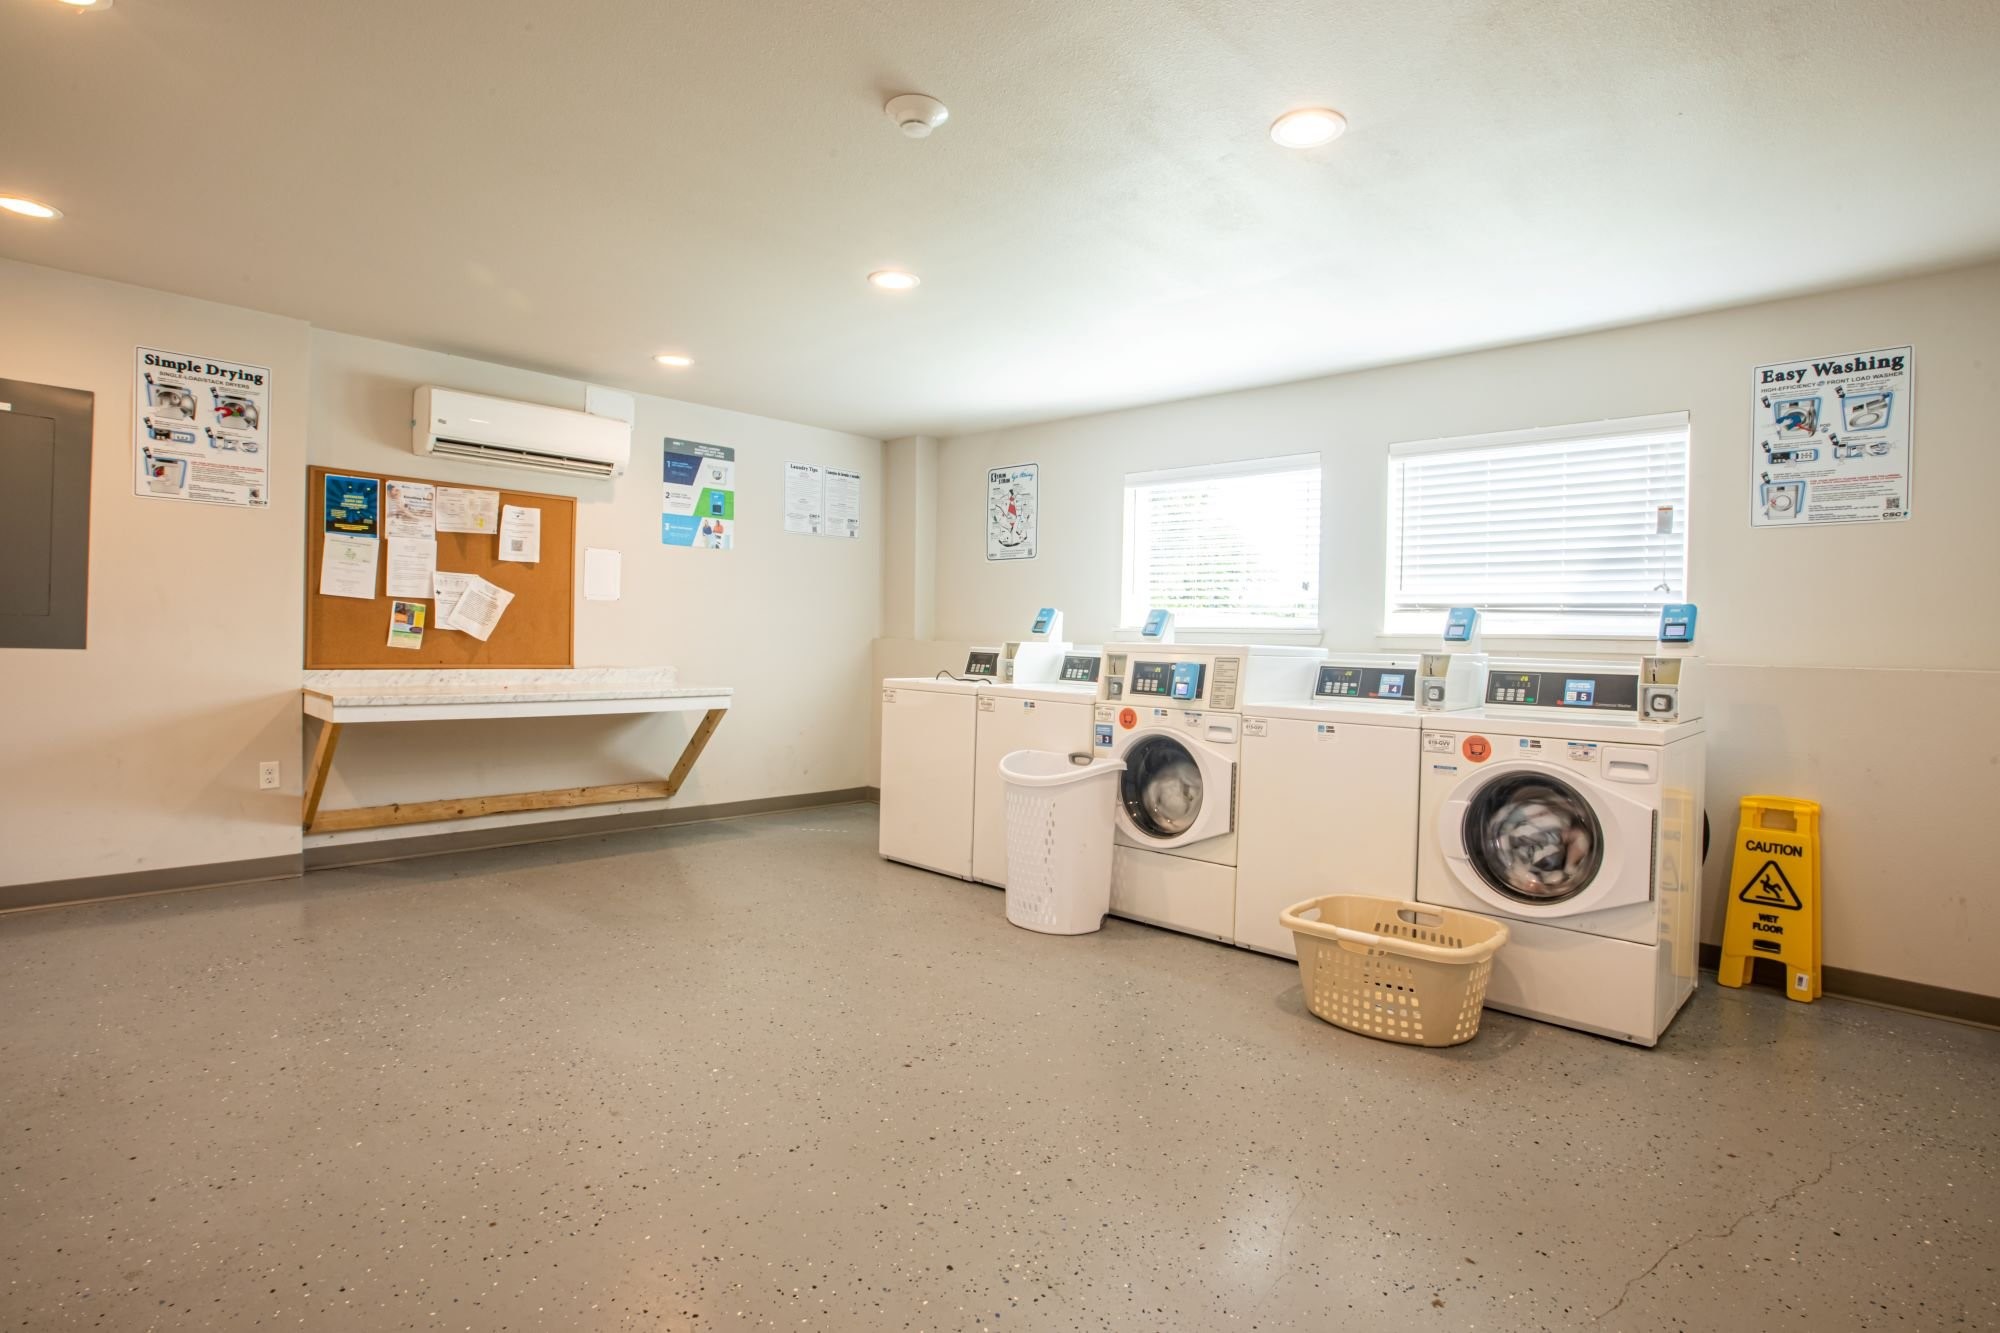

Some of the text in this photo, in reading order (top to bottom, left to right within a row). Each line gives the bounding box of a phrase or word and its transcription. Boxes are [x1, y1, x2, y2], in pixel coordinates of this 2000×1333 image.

[144, 353, 264, 386] Simple Drying
[1761, 355, 1905, 384] Easy Washing
[1761, 382, 1817, 393] HIGH-EFFICIENCY
[1827, 377, 1850, 385] FRONT
[1873, 371, 1904, 379] WASHER
[1391, 685, 1397, 693] 4
[1580, 693, 1587, 701] 5
[1104, 735, 1110, 743] 3
[1745, 840, 1803, 857] CAUTION
[1758, 913, 1779, 924] WET
[1752, 922, 1783, 935] FLOOR
